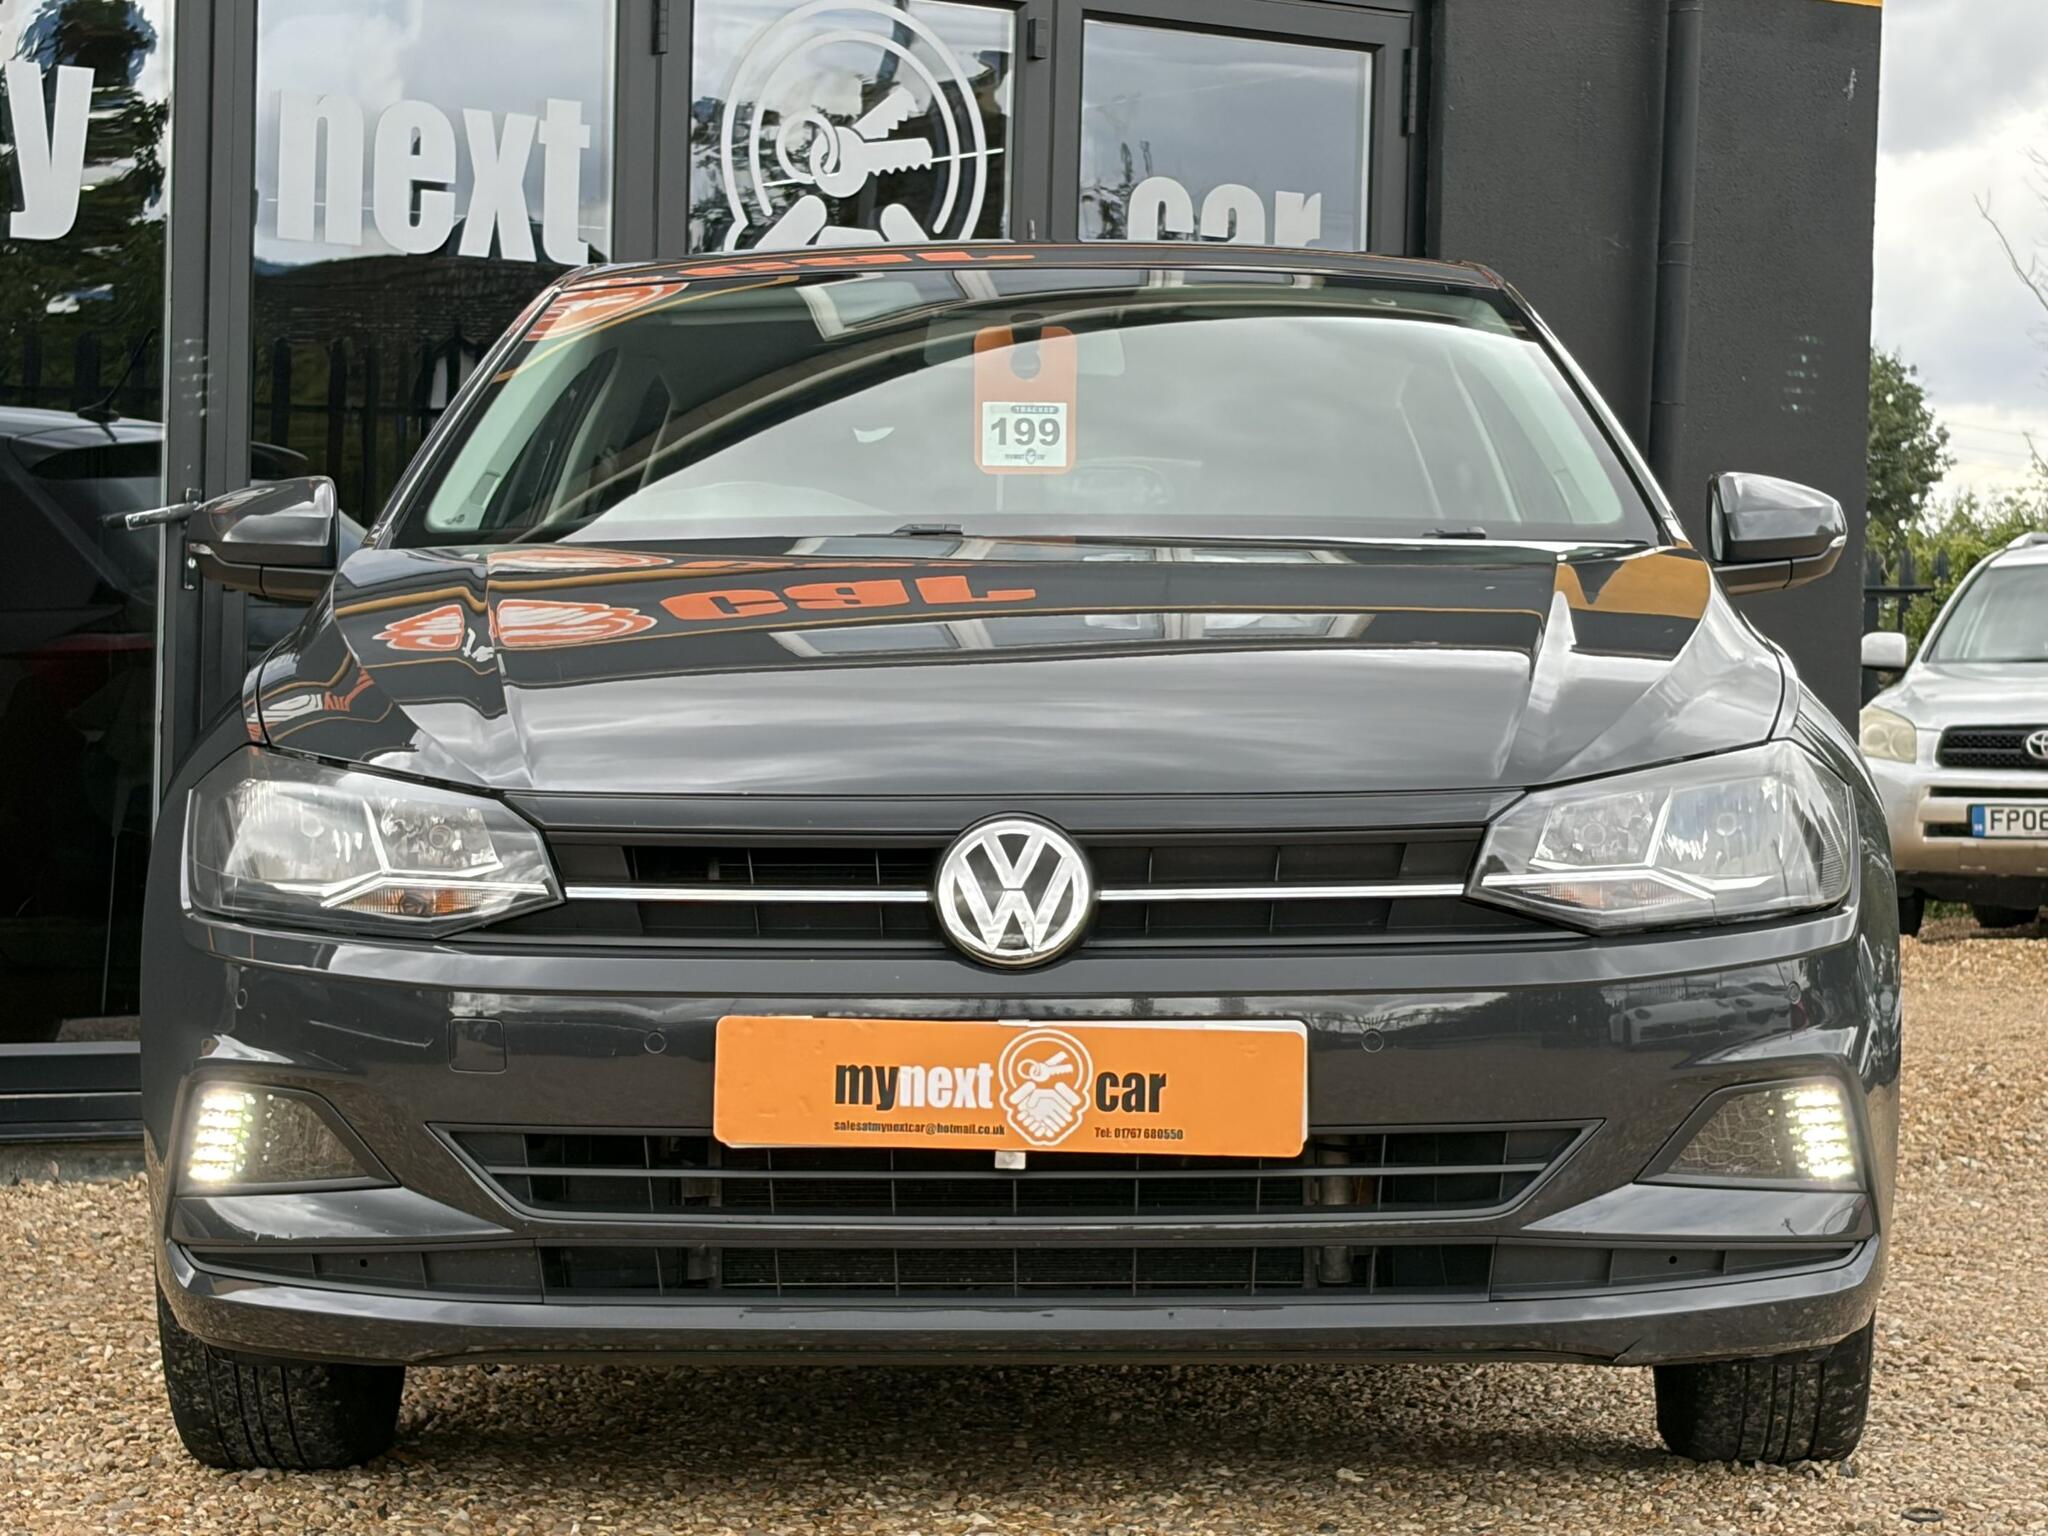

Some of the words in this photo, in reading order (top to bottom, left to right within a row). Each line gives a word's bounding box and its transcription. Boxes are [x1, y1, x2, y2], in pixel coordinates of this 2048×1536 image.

[276, 90, 590, 266] next
[991, 417, 1060, 446] 199
[944, 824, 1083, 955] VW
[1095, 1071, 1168, 1113] car
[1114, 1127, 1142, 1139] 01767
[1143, 1128, 1184, 1140] 680550
